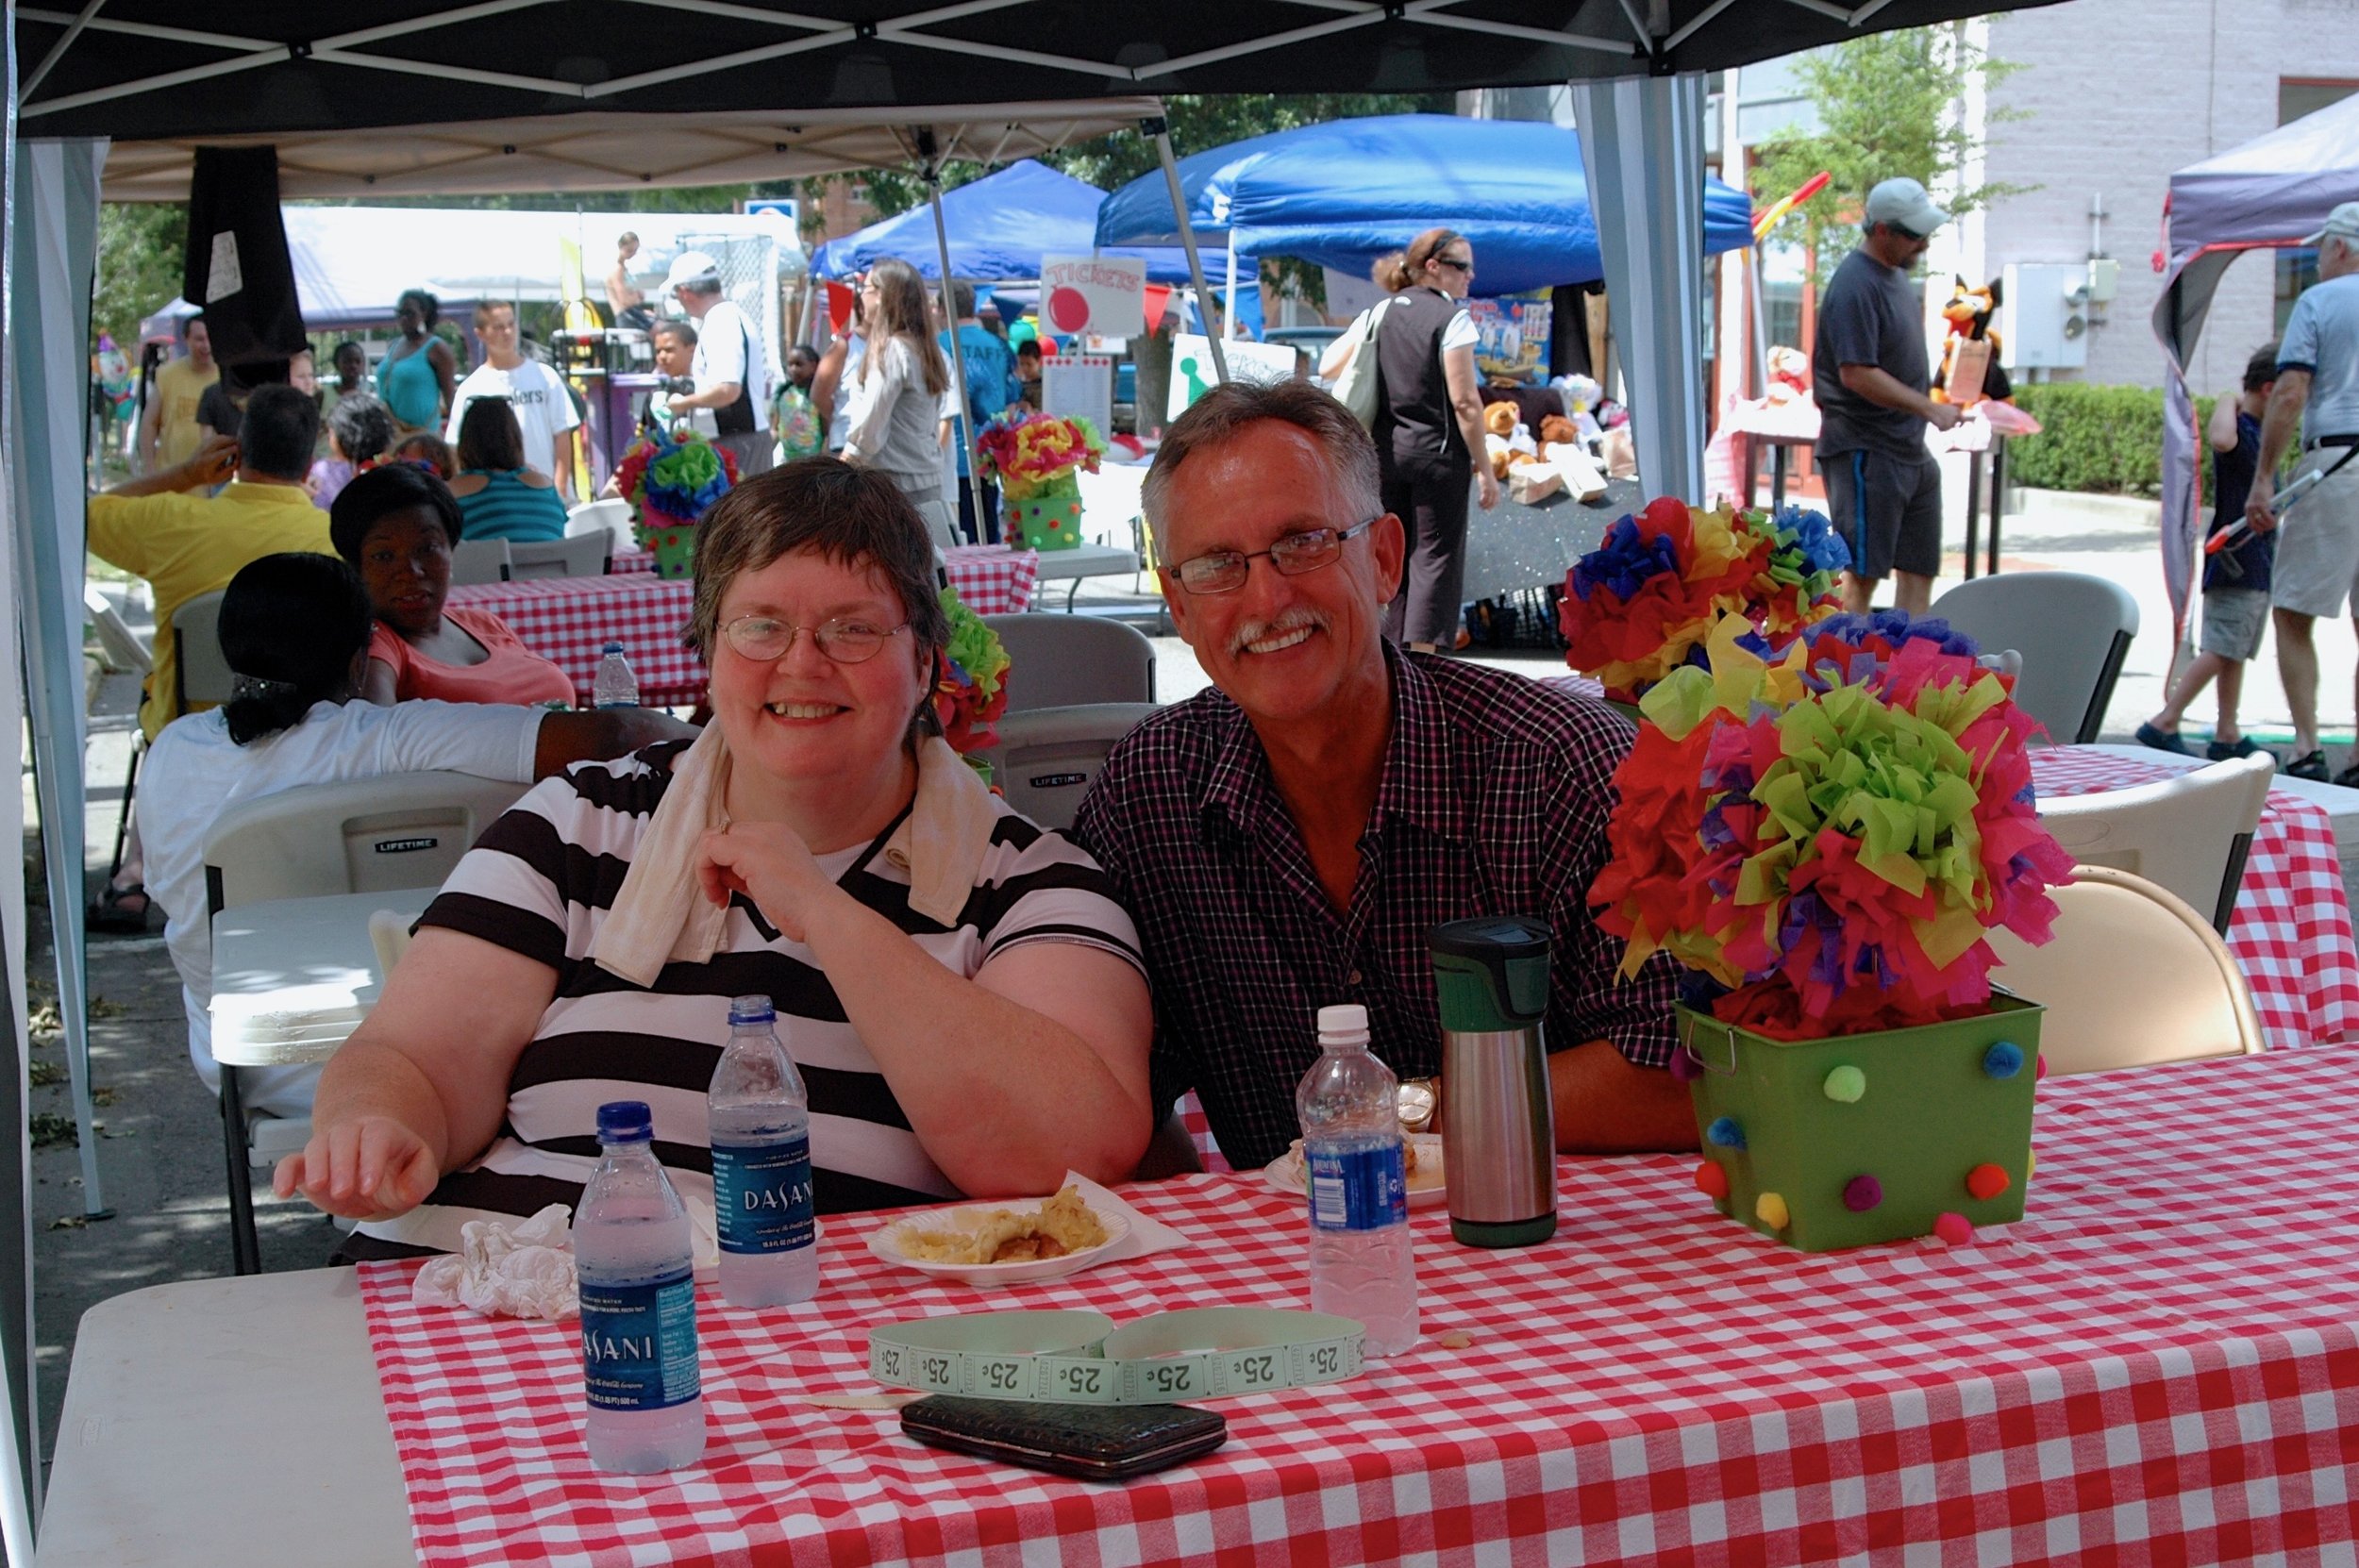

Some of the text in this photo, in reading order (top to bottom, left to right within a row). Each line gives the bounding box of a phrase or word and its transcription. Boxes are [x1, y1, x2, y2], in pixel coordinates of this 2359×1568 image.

[1046, 263, 1140, 292] TICKETS
[962, 345, 1001, 360] TAFF
[1035, 775, 1082, 786] LIFETIME
[379, 840, 432, 851] LIFETIME
[583, 1329, 652, 1363] ASANI
[882, 1349, 900, 1376] 25¢
[922, 1358, 949, 1384] 25¢
[1233, 1356, 1274, 1384] 25¢
[1309, 1346, 1338, 1375] 25¢
[981, 1362, 1019, 1390] 25¢
[1060, 1366, 1101, 1394] 25¢
[1146, 1364, 1191, 1393] 25¢
